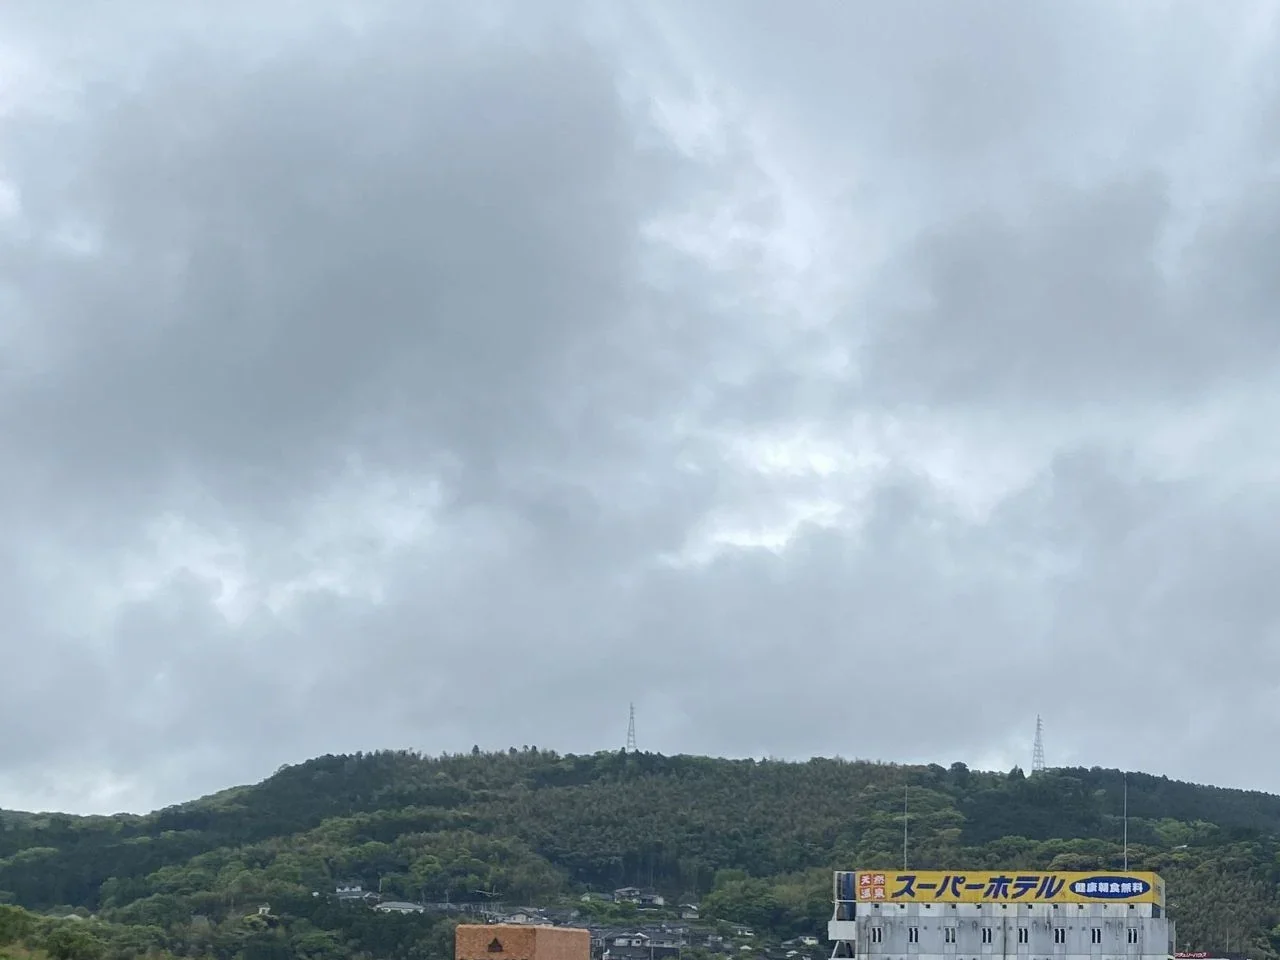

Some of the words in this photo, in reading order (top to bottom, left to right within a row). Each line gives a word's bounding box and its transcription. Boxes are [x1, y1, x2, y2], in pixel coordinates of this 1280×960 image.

[891, 875, 1066, 899] スーパーホテル
[1074, 882, 1144, 894] 健康朝食無料
